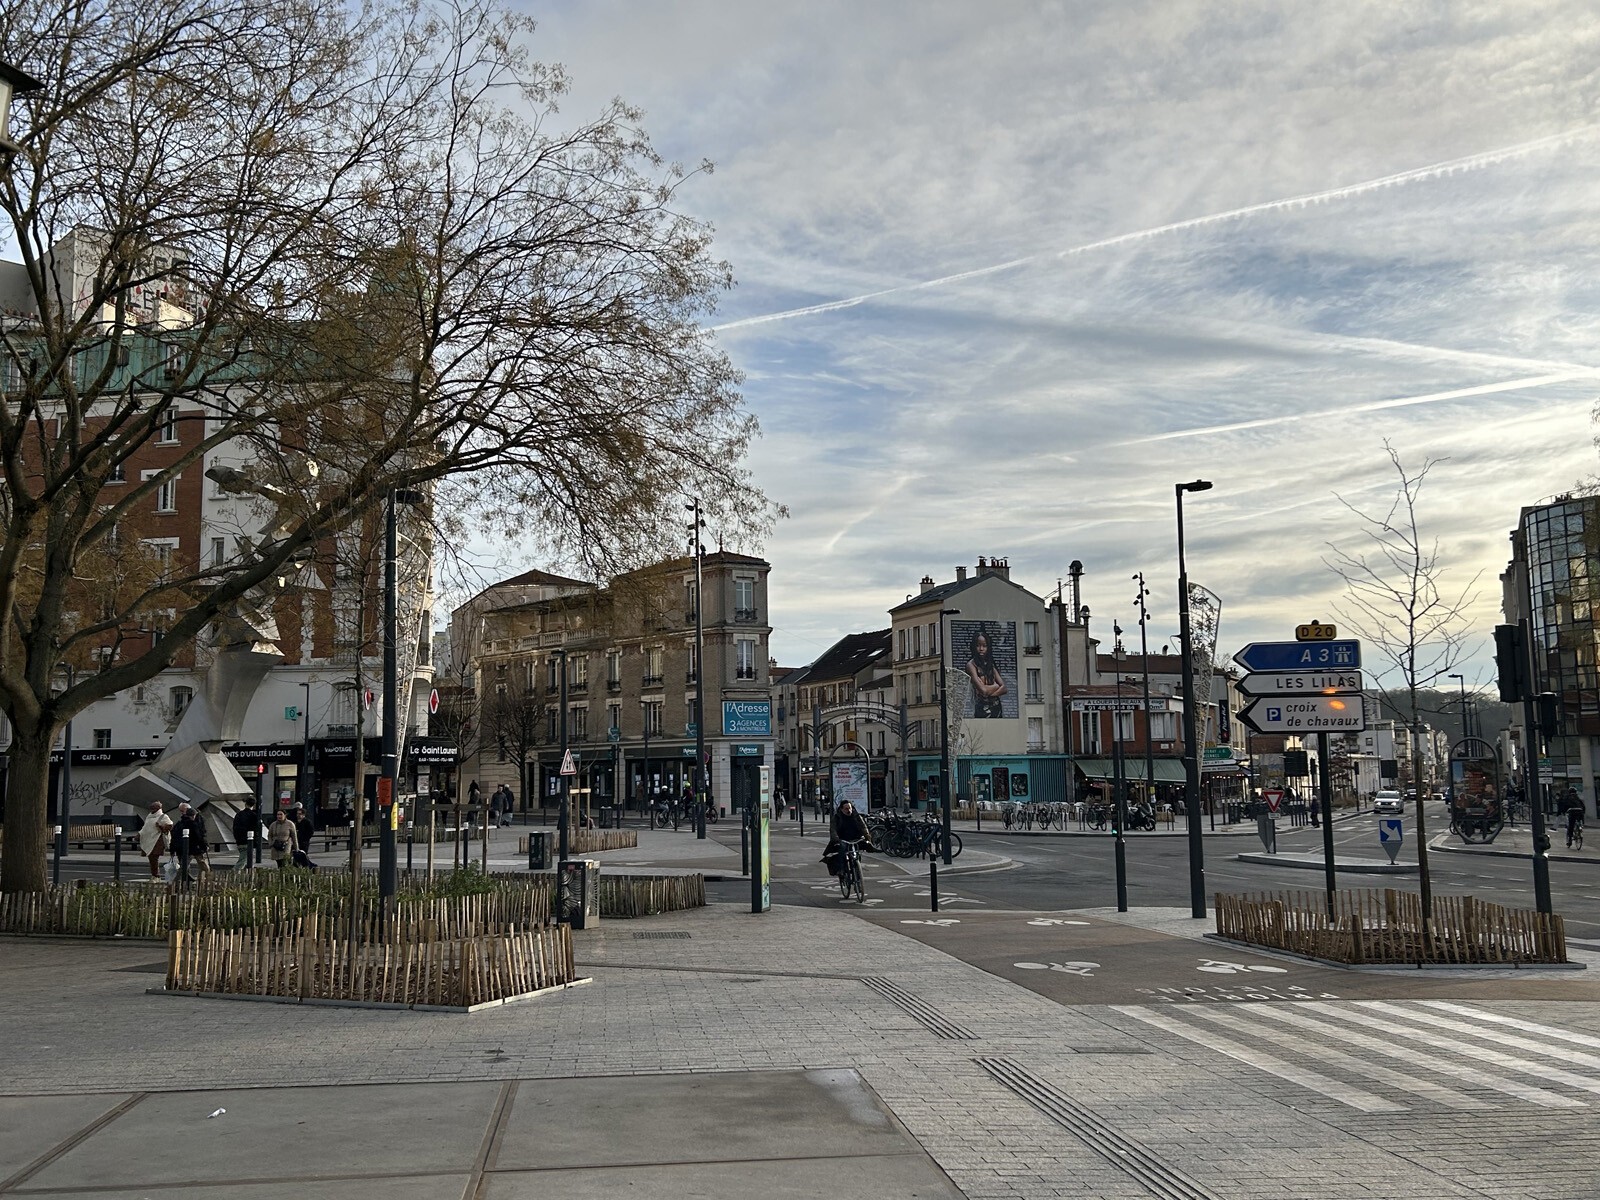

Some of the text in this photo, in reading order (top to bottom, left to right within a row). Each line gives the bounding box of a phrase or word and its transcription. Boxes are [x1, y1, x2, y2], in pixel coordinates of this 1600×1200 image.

[1301, 627, 1333, 637] D 20
[1301, 648, 1329, 663] A 3
[1276, 676, 1356, 689] LES LILAS
[726, 702, 769, 715] l'Adresse
[1269, 702, 1317, 720] P croix
[729, 720, 737, 732] 3
[1286, 715, 1359, 727] de chavaux
[240, 748, 267, 757] D'UTILITÉ
[268, 749, 291, 757] LOCALE
[410, 745, 420, 755] Le
[421, 745, 440, 755] Saint
